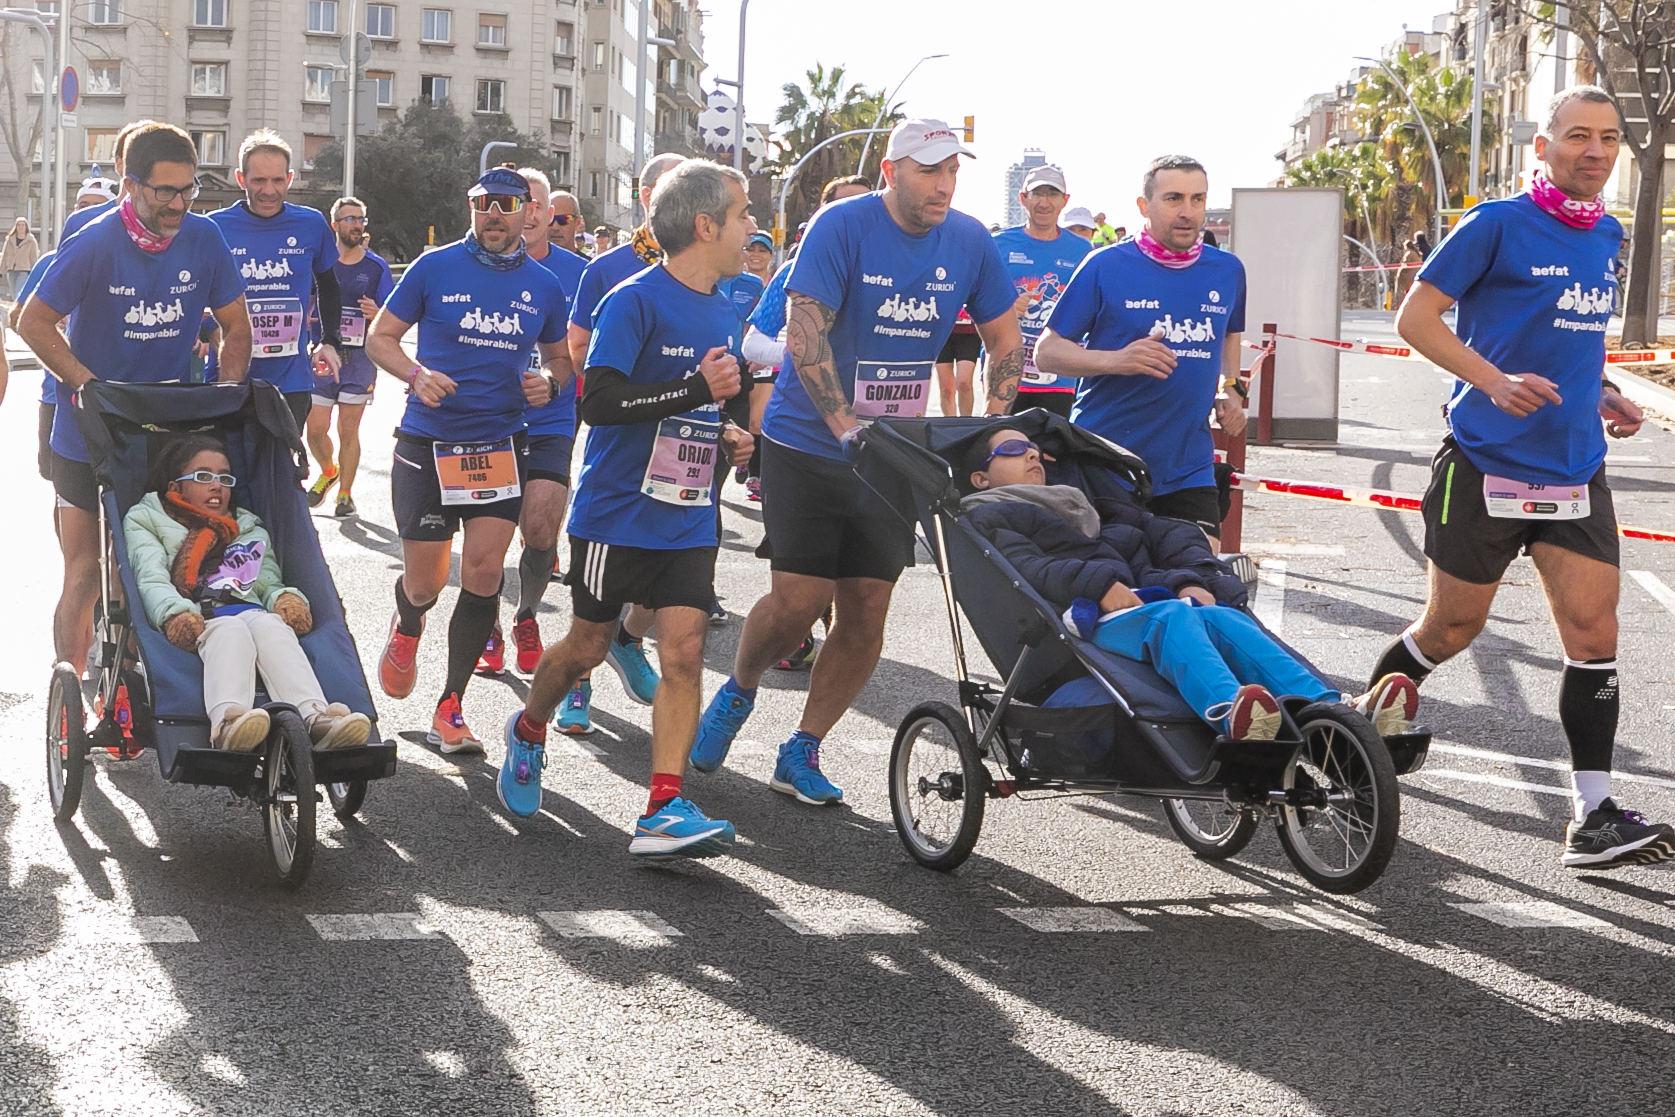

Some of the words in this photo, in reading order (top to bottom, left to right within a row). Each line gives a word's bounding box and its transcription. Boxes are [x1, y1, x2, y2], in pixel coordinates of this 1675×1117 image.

[1531, 265, 1569, 276] aefat
[863, 273, 893, 287] aefat
[109, 285, 135, 296] aefat
[170, 283, 198, 294] ZURICH
[926, 283, 955, 291] ZURICH
[442, 293, 471, 303] aefat
[1125, 299, 1160, 309] aefat
[510, 301, 538, 315] ZURICH
[1200, 304, 1227, 314] ZURICH
[249, 315, 279, 328] OSEP
[284, 315, 293, 327] M
[124, 329, 180, 341] #Imparables
[874, 325, 931, 338] #Imparables
[458, 336, 518, 351] #Imparables
[661, 346, 695, 358] aefat
[865, 384, 922, 401] GONZALO
[884, 404, 899, 413] 320
[460, 455, 493, 471] ABEL
